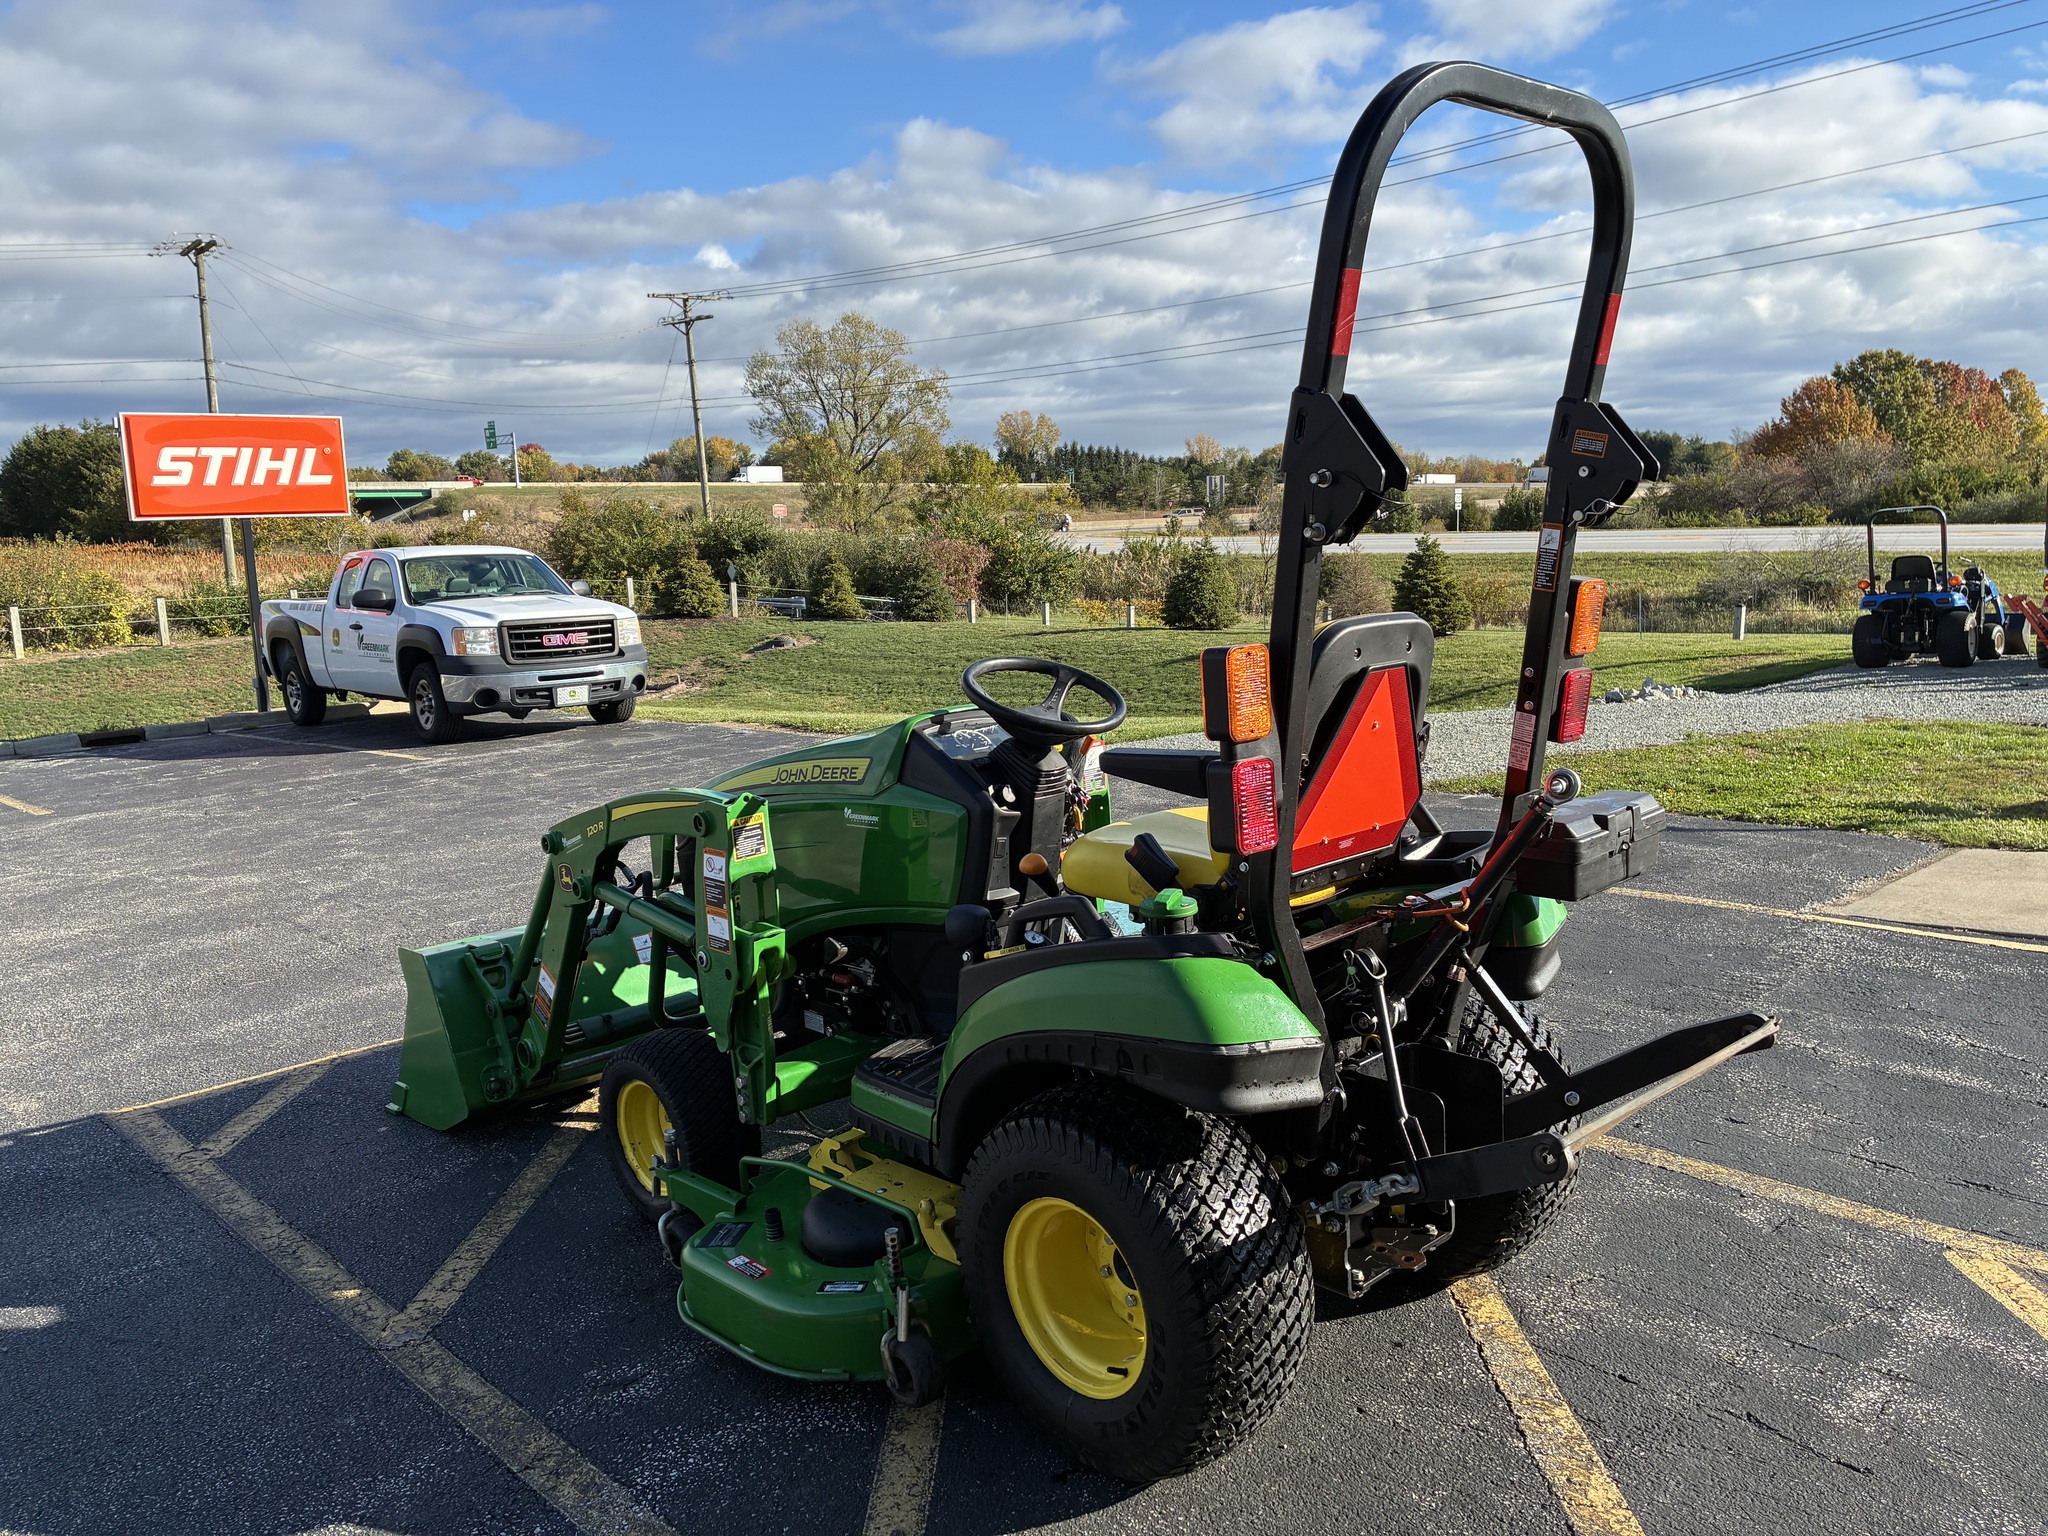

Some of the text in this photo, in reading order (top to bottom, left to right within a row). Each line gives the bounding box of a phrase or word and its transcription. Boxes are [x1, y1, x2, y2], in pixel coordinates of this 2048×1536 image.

[151, 447, 333, 486] STIHL
[543, 632, 588, 646] GMC
[362, 642, 389, 653] GREENMARK
[771, 765, 859, 782] JOHN DEERE
[740, 814, 762, 825] CAUTION
[1092, 1318, 1166, 1440] CARLISLE
